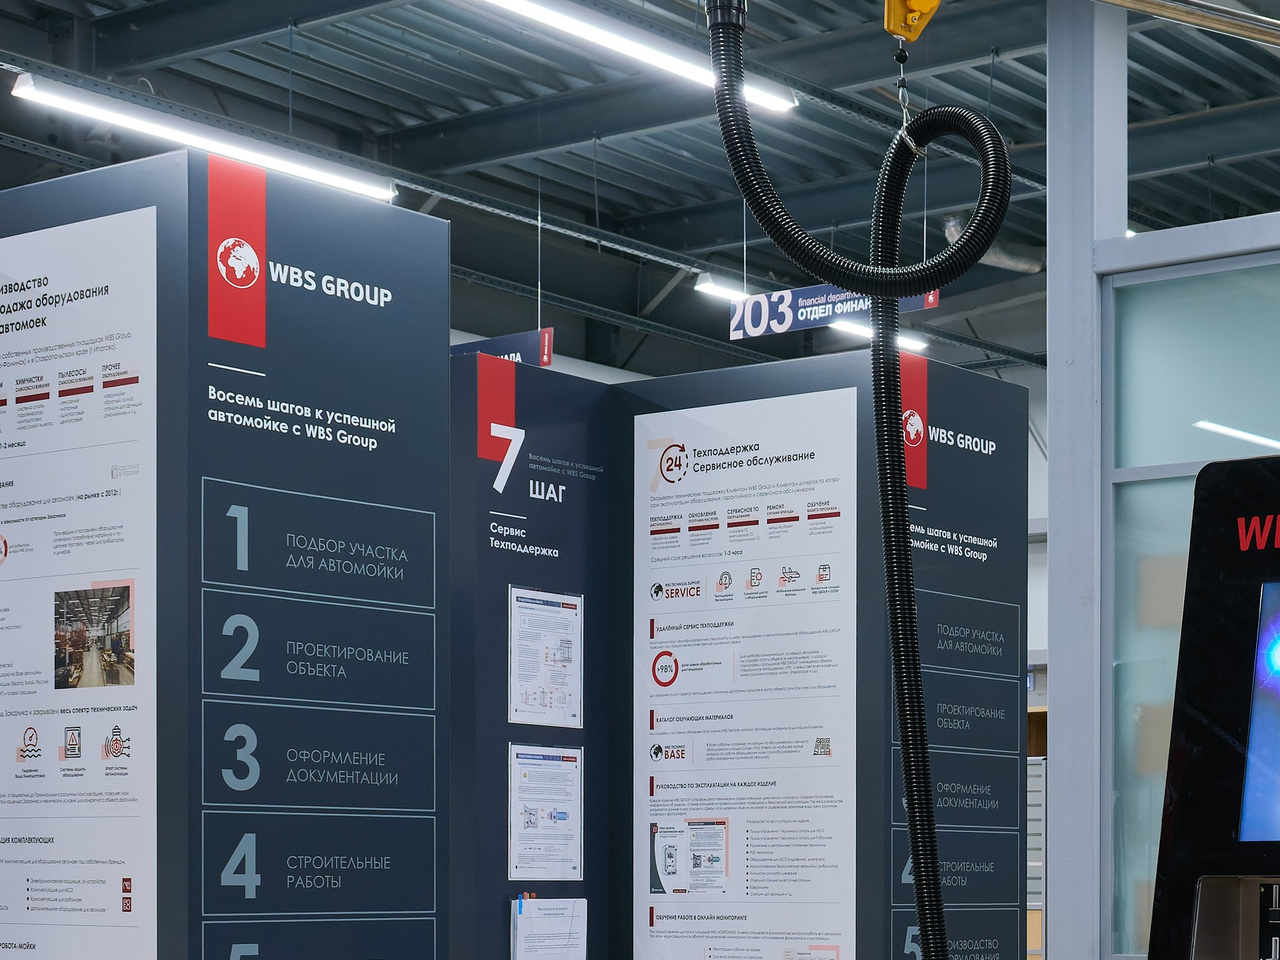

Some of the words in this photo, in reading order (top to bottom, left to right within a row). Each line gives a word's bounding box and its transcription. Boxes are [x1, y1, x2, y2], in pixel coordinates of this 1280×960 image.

[268, 261, 316, 291] WBS
[321, 275, 393, 307] GROUP
[36, 285, 109, 308] оборудования
[798, 293, 827, 307] financial
[730, 289, 793, 340] 203
[797, 303, 832, 321] ОТДЕЛ
[834, 298, 871, 315] ФИНАН
[58, 368, 87, 379] ПЫЛЕСОСЫ
[101, 362, 121, 372] ПРОЧЕЕ
[15, 375, 44, 386] ХИМЧИСТКИ
[208, 385, 263, 408] Восемь
[267, 399, 311, 418] шагов
[315, 408, 324, 421] к
[326, 411, 396, 433] успешной
[208, 408, 288, 433] автомойке
[292, 424, 302, 436] с
[305, 423, 333, 442] WBS
[336, 430, 378, 451] Group
[928, 425, 954, 446] WBS
[956, 433, 996, 455] GROUP
[490, 422, 526, 494] 7
[692, 442, 760, 458] Техподдержка
[528, 452, 551, 463] Восемь
[551, 458, 570, 467] шагов
[575, 461, 604, 473] успешной
[528, 462, 561, 474] автомойке
[566, 469, 579, 478] WBS
[579, 471, 596, 481] Group
[665, 456, 682, 472] 24
[692, 459, 744, 473] Сервисное
[746, 451, 816, 468] обслуживание
[529, 479, 566, 503] ШАГ
[226, 505, 248, 571] 1
[490, 522, 527, 538] Сервис
[910, 523, 925, 534] емь
[927, 526, 952, 540] шагов
[953, 531, 958, 541] к
[958, 533, 998, 549] успешной
[286, 533, 346, 553] ПОДБОР
[349, 542, 408, 562] УЧАСТКА
[489, 536, 559, 558] Техподдержка
[910, 538, 939, 552] омойке
[941, 544, 946, 553] с
[947, 544, 963, 557] WBS
[964, 547, 988, 562] Group
[285, 553, 314, 569] ДЛЯ
[318, 557, 404, 580] АВТОМОЙКИ
[665, 586, 701, 599] SERVICE
[937, 623, 971, 638] ПОДБОР
[971, 628, 1005, 643] УЧАСТКА
[220, 613, 260, 682] 2
[286, 641, 409, 665] ПРОЕКТИРОВАНИЕ
[937, 639, 953, 650] ДЛЯ
[954, 642, 1003, 657] АВТОМОЙКИ
[286, 660, 347, 678] ОБЪЕКТА
[72, 707, 90, 715] спектр
[91, 705, 121, 713] технических
[936, 703, 1005, 720] ПРОЕКТИРОВАНИЕ
[936, 717, 971, 730] ОБЪЕКТА
[221, 723, 261, 791] 3
[286, 748, 386, 766] ОФОРМЛЕНИЕ
[664, 750, 686, 760] BASE
[285, 768, 398, 786] ДОКУМЕНТАЦИИ
[936, 782, 992, 795] ОФОРМЛЕНИЕ
[936, 797, 999, 810] ДОКУМЕНТАЦИИ
[220, 833, 261, 899] 4
[286, 855, 391, 870] СТРОИТЕЛЬНЫЕ
[938, 861, 995, 873] СТРОИТЕЛЬНЫЕ
[286, 875, 341, 888] РАБОТЫ
[947, 938, 999, 951] ОИЗВОДСТВО
